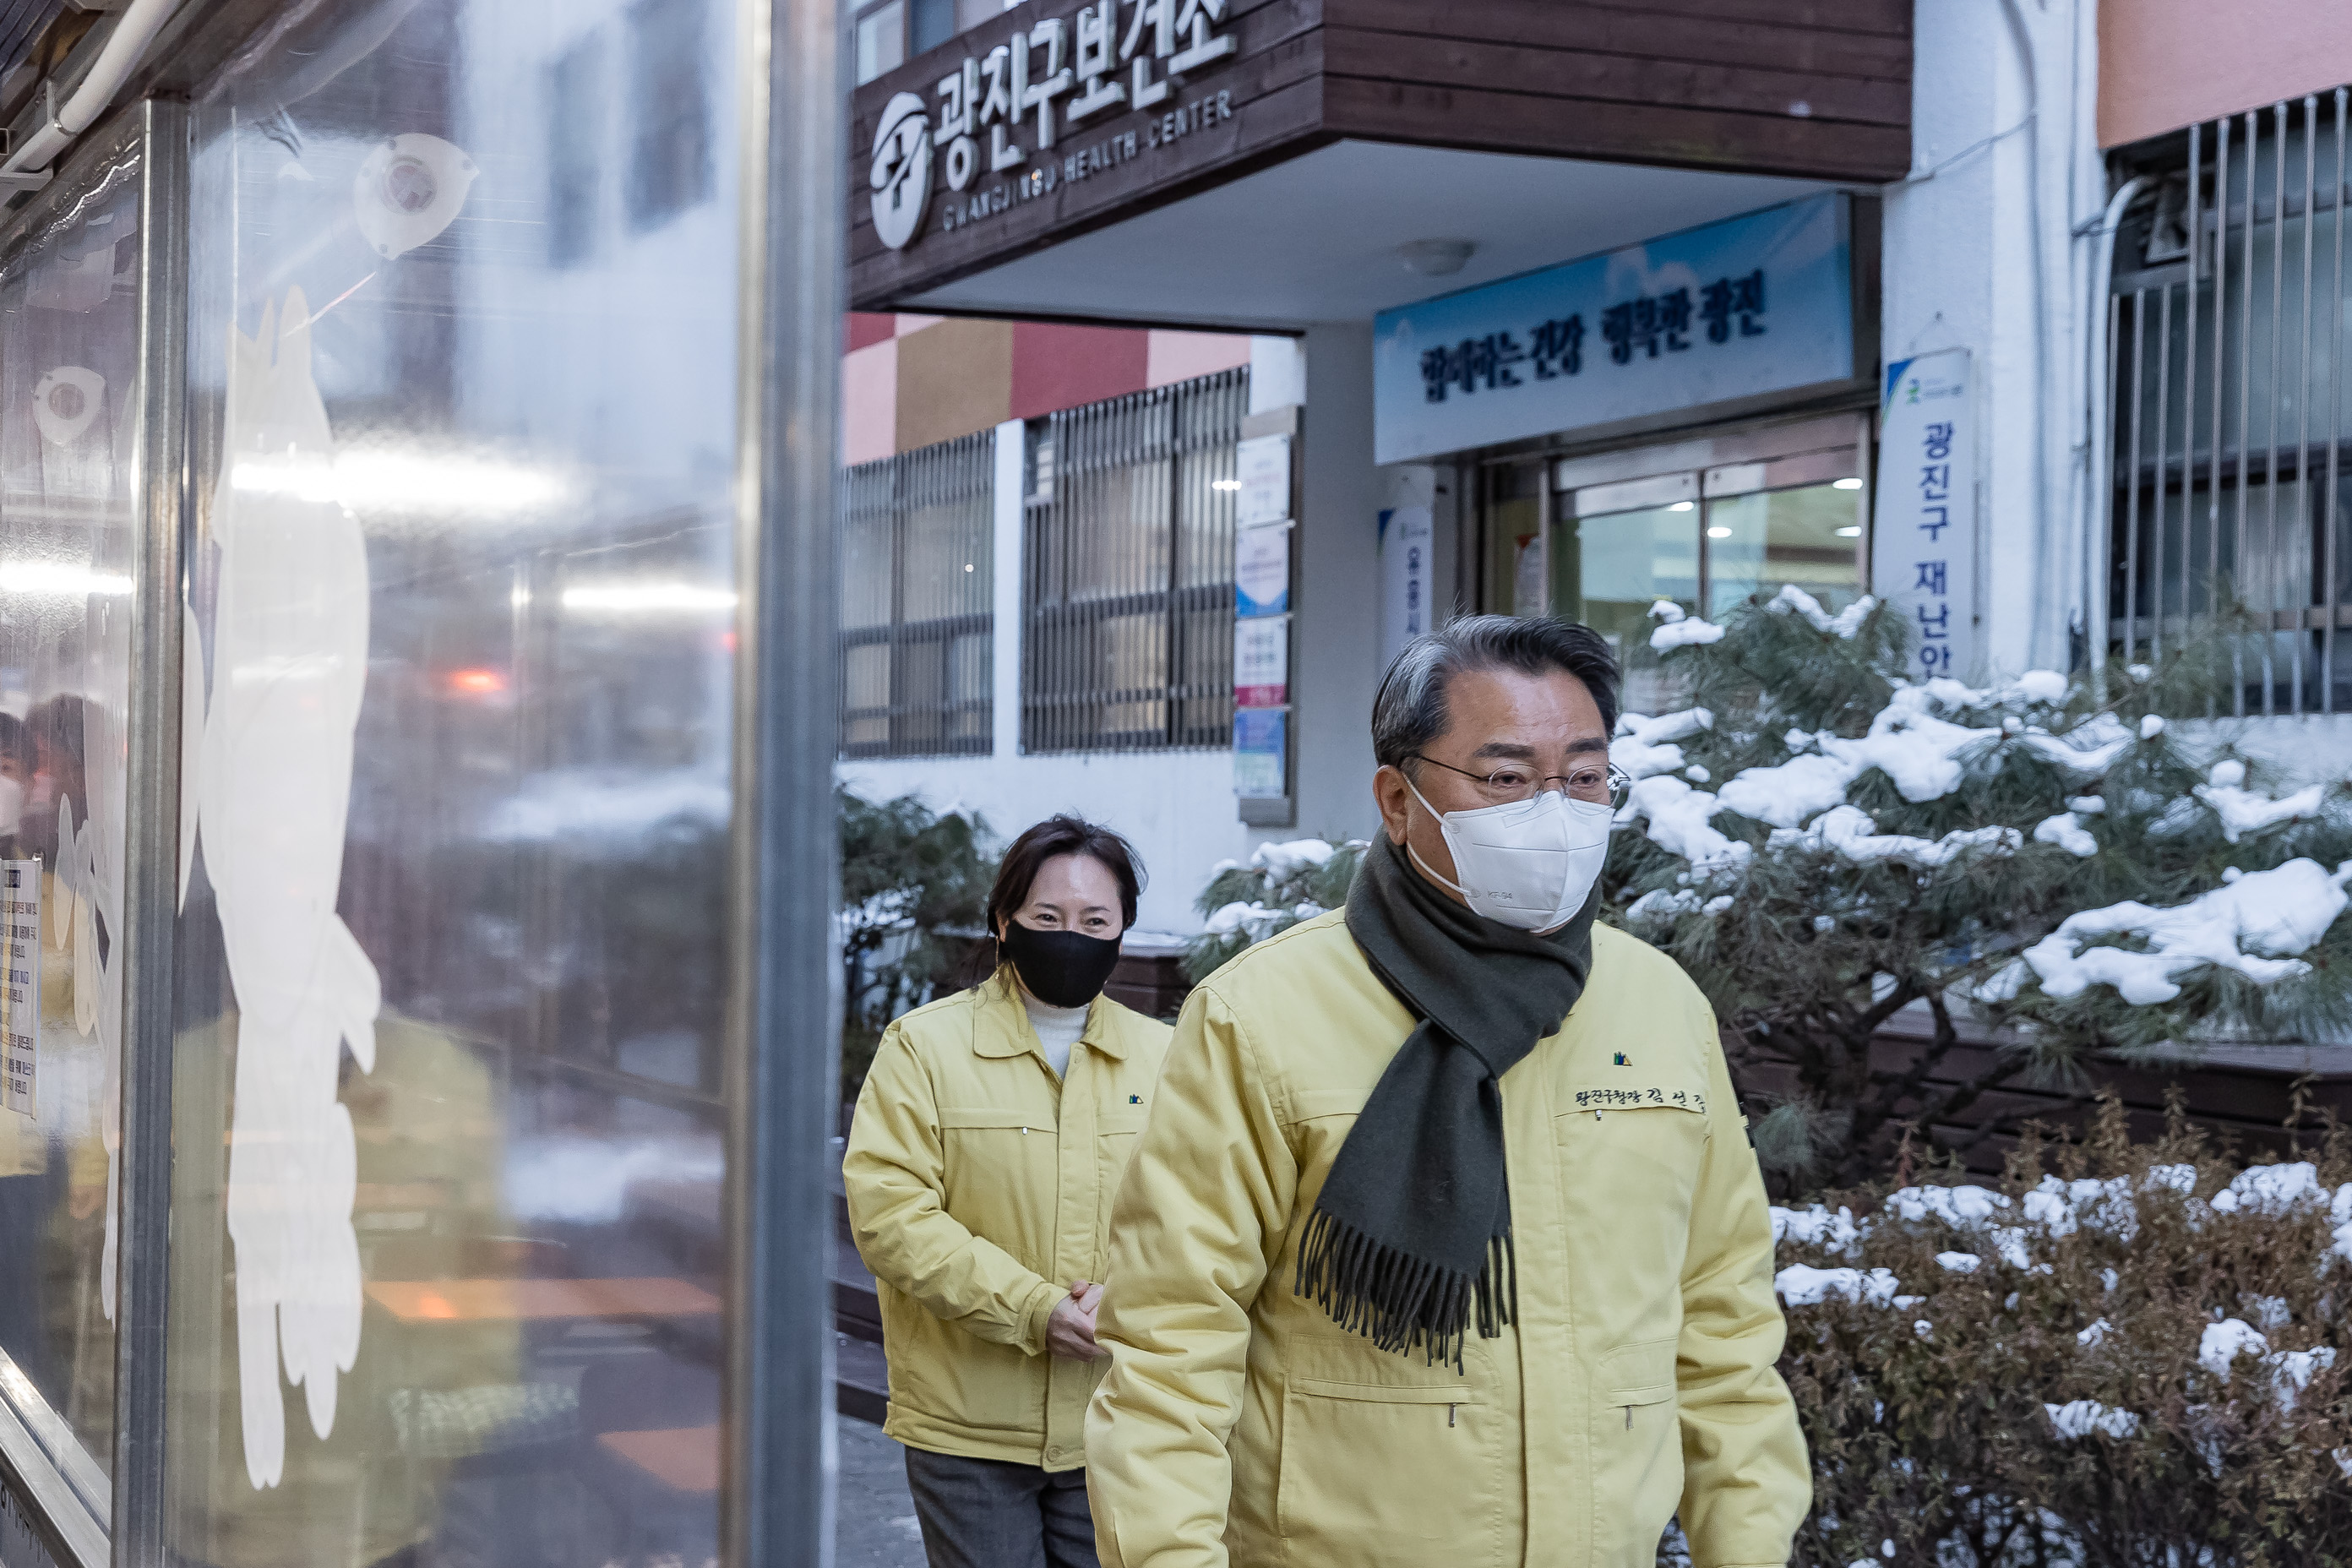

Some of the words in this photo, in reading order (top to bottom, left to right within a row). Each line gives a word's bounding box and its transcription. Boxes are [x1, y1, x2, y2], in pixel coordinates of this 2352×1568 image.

[933, 0, 1237, 192] 광진구보건소
[1064, 130, 1137, 183] HEALTH
[1148, 89, 1232, 150] CENTER
[1528, 313, 1587, 380] 건강
[1603, 287, 1692, 366] 행복한
[1698, 268, 1767, 345] 광진
[1915, 420, 1957, 543] 광진구
